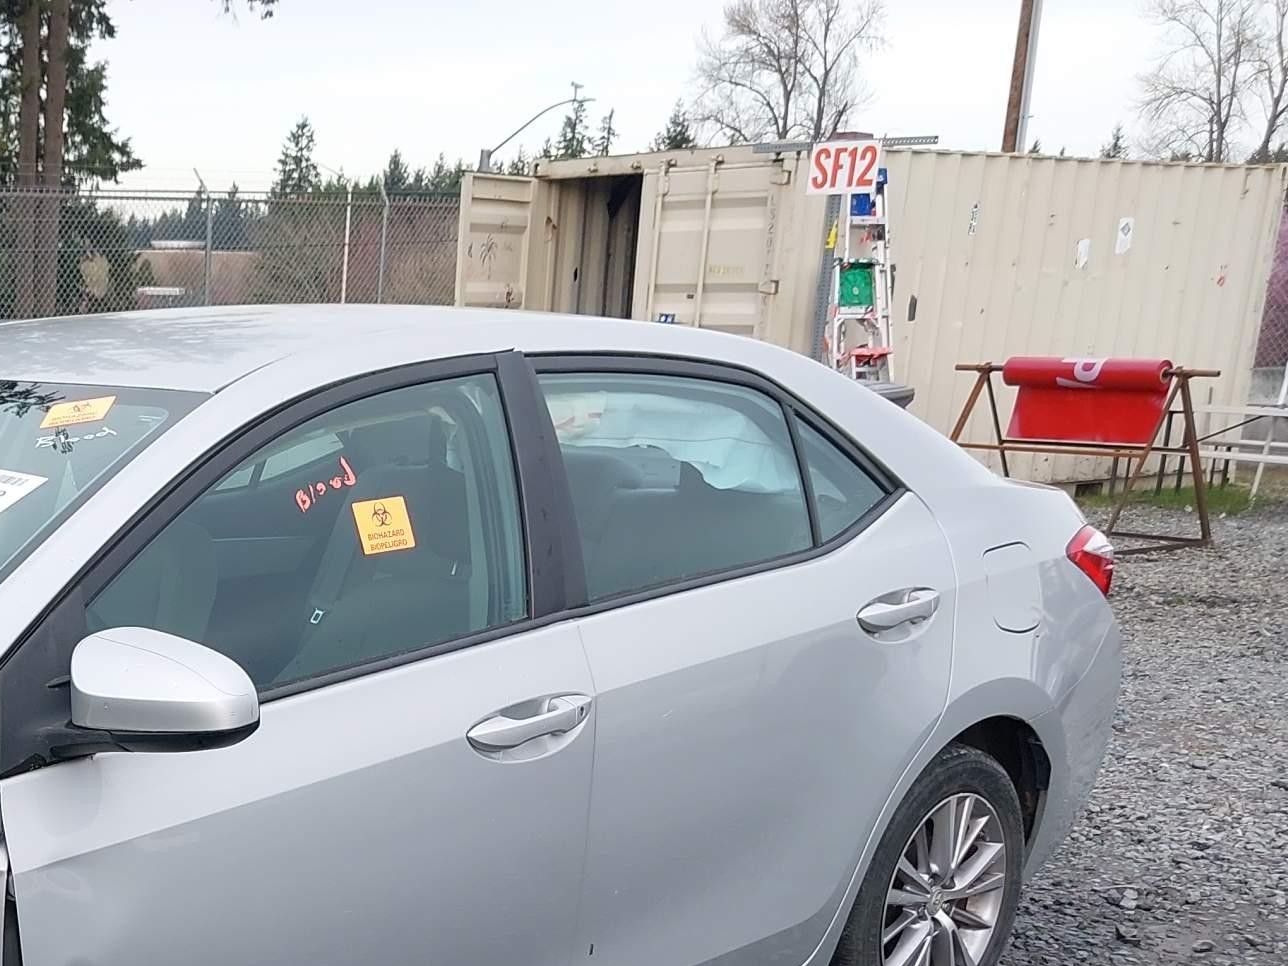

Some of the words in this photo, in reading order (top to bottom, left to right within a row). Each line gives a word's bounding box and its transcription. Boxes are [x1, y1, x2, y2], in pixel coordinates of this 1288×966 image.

[811, 145, 878, 190] SF12
[294, 456, 357, 513] Blood
[367, 528, 405, 542] BIOHAZARD
